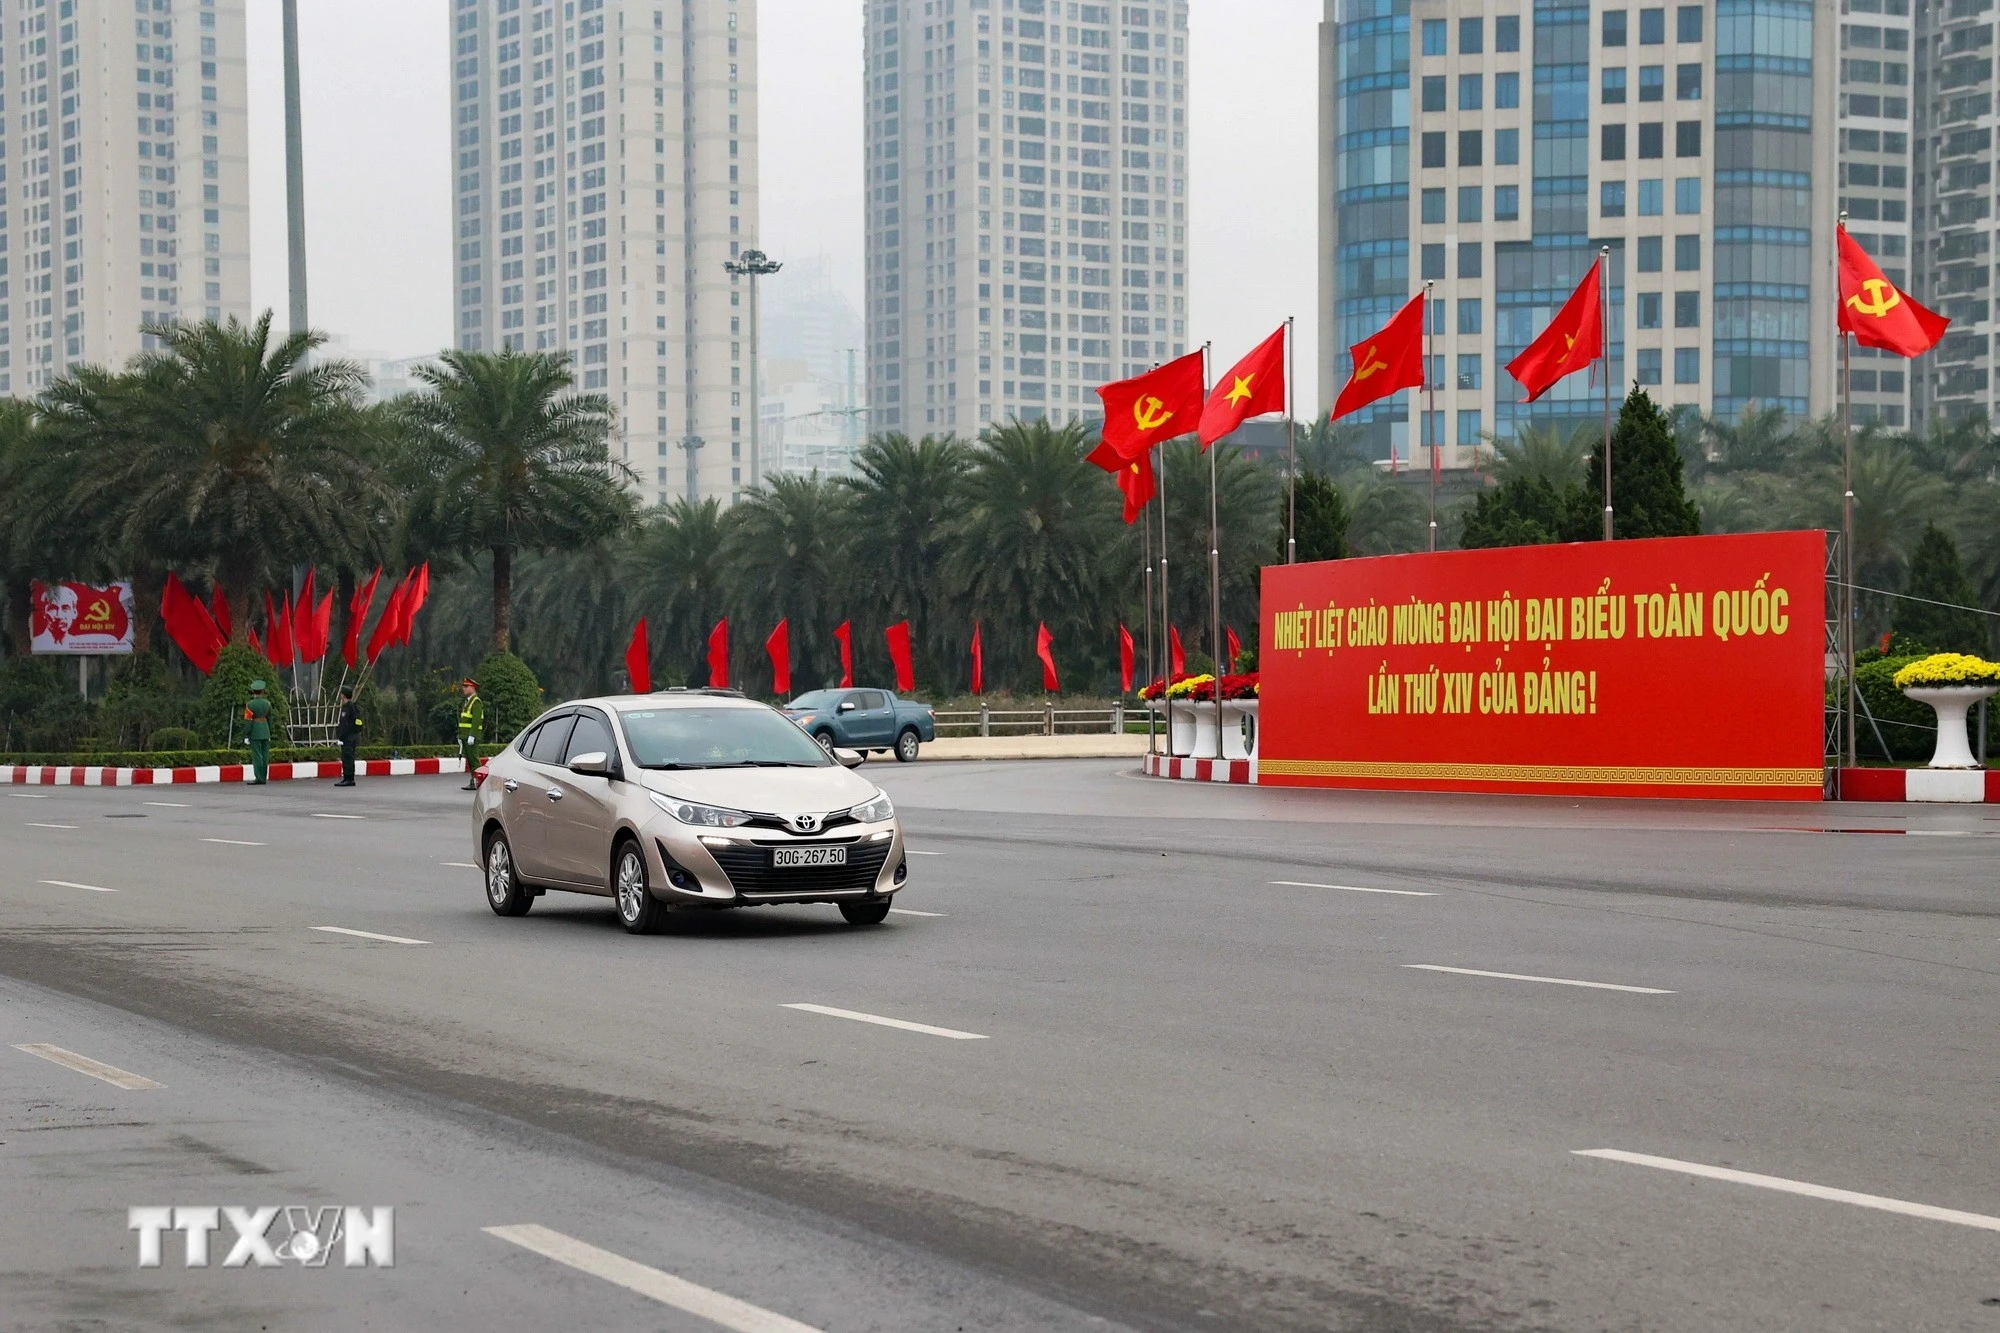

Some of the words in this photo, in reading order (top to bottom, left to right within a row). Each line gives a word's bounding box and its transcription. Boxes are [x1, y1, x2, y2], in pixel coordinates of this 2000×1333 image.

[1274, 602, 1312, 657] NHIỆT
[1315, 600, 1344, 656] LIỆT
[1347, 599, 1388, 647] CHÀO
[1393, 596, 1444, 645] MỪNG
[1449, 601, 1482, 652] ĐẠI
[1487, 591, 1519, 651] HỘI
[1526, 598, 1563, 650] ĐẠI
[1571, 577, 1625, 639] BIỂU
[1634, 583, 1703, 638] TOÀN
[1713, 573, 1789, 641] QUỐC
[1369, 660, 1399, 714] LẦN
[1404, 664, 1439, 714] THỨ
[1443, 672, 1473, 714] XIV
[1479, 658, 1518, 714] CỦA
[776, 849, 845, 865] 30G-267.50
